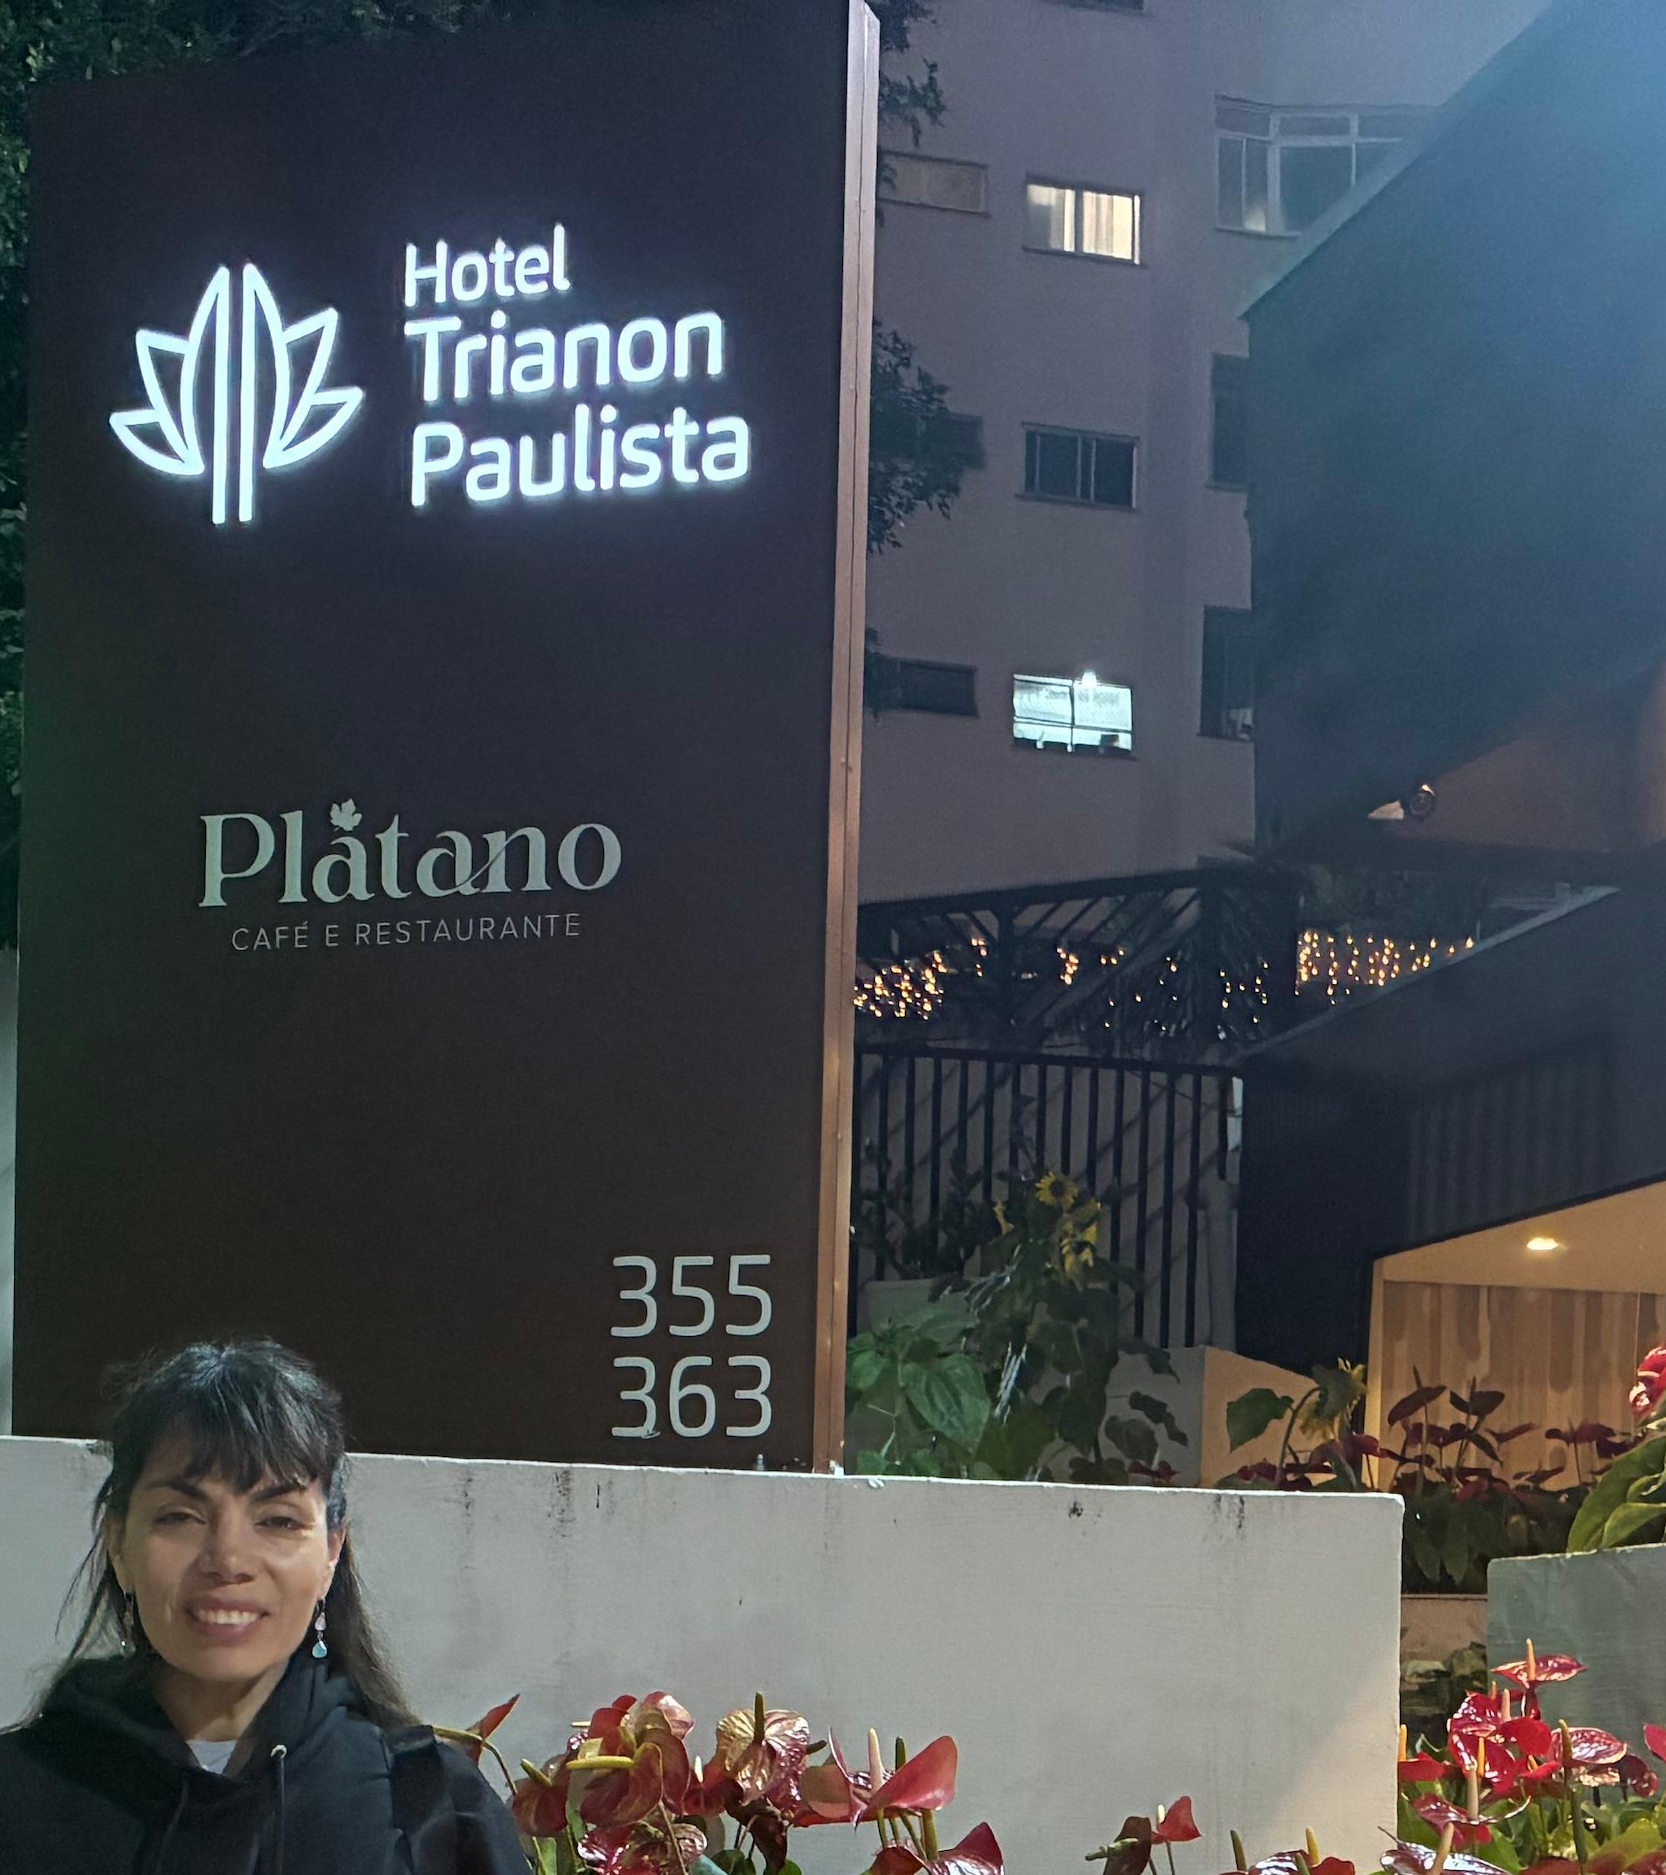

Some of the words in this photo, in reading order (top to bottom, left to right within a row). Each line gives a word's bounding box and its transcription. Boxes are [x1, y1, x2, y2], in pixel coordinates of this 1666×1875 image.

[404, 223, 571, 306] Hotel
[404, 310, 723, 403] Trianon
[411, 404, 749, 507] Paulista
[231, 920, 309, 951] CAFÉ
[325, 924, 340, 947] E
[355, 912, 581, 947] RESTAURANTE
[610, 1254, 773, 1337] 355
[611, 1355, 773, 1438] 363
